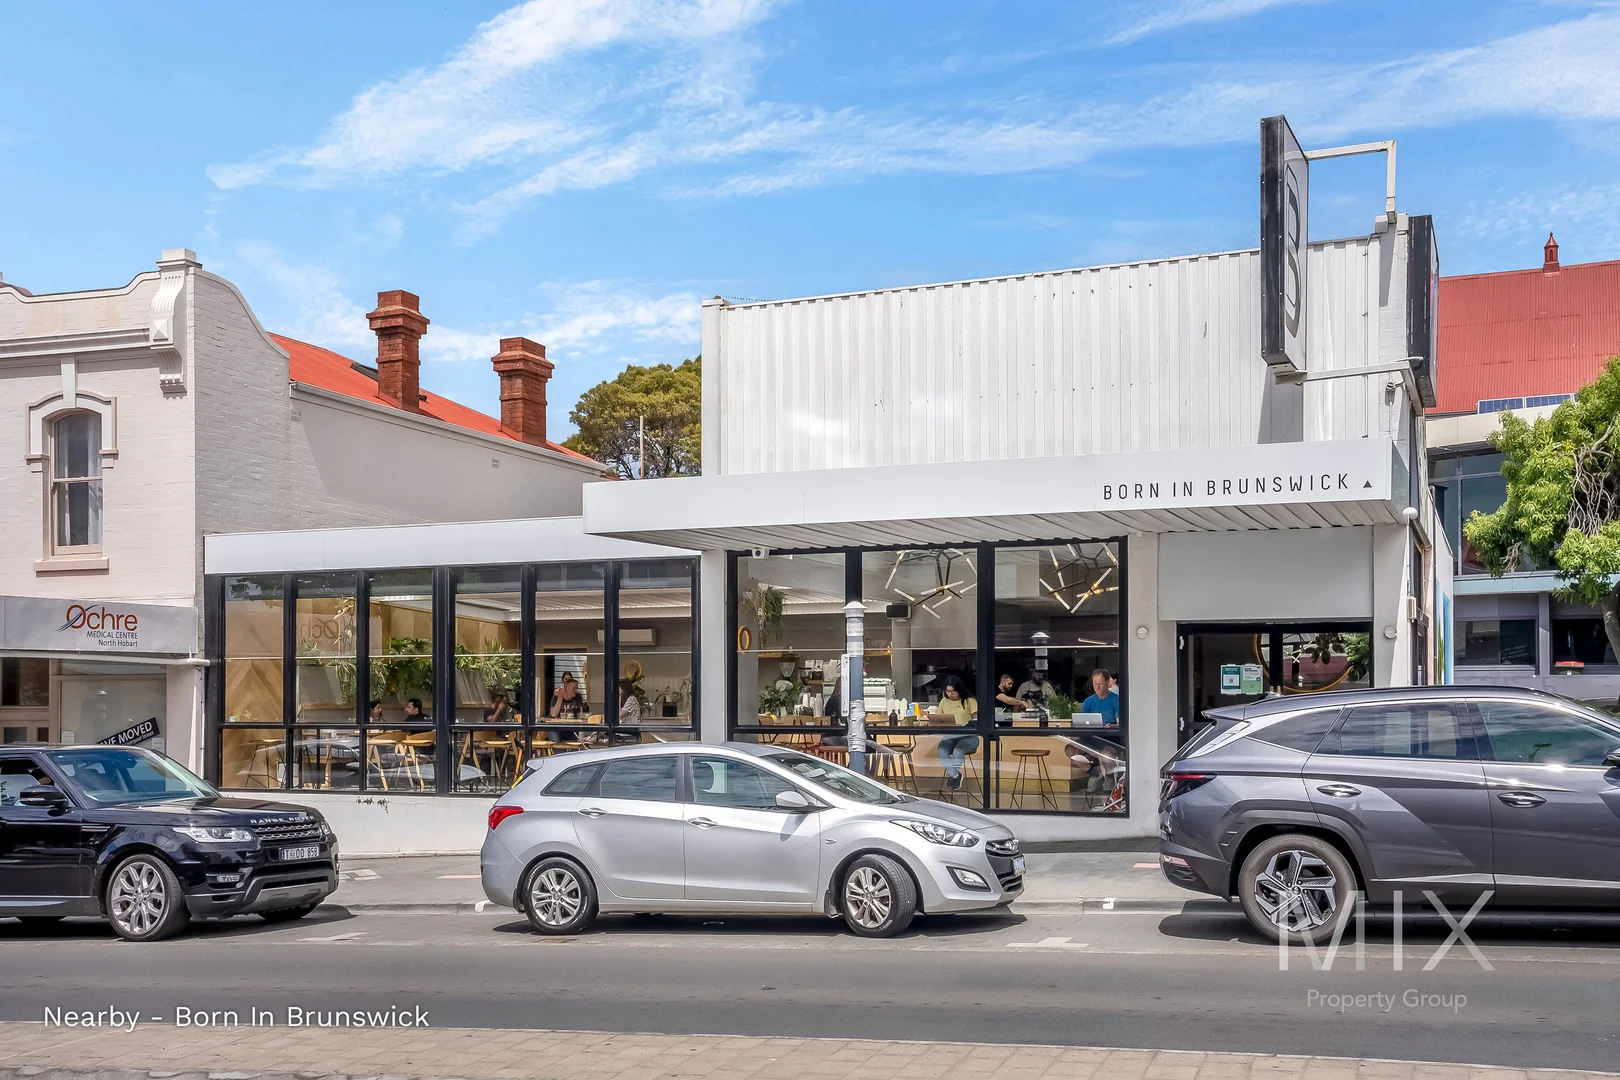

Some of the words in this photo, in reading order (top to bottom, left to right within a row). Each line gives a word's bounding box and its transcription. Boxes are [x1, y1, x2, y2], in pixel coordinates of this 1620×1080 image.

[1103, 482, 1159, 500] BORN
[1172, 480, 1193, 498] IN
[1207, 472, 1349, 496] BRUNSWICK
[66, 604, 138, 631] Ochre
[86, 630, 115, 639] MEDICAL
[115, 631, 138, 640] CENTRE
[98, 639, 117, 647] North
[117, 640, 138, 648] Hobart
[118, 721, 153, 744] MOVED
